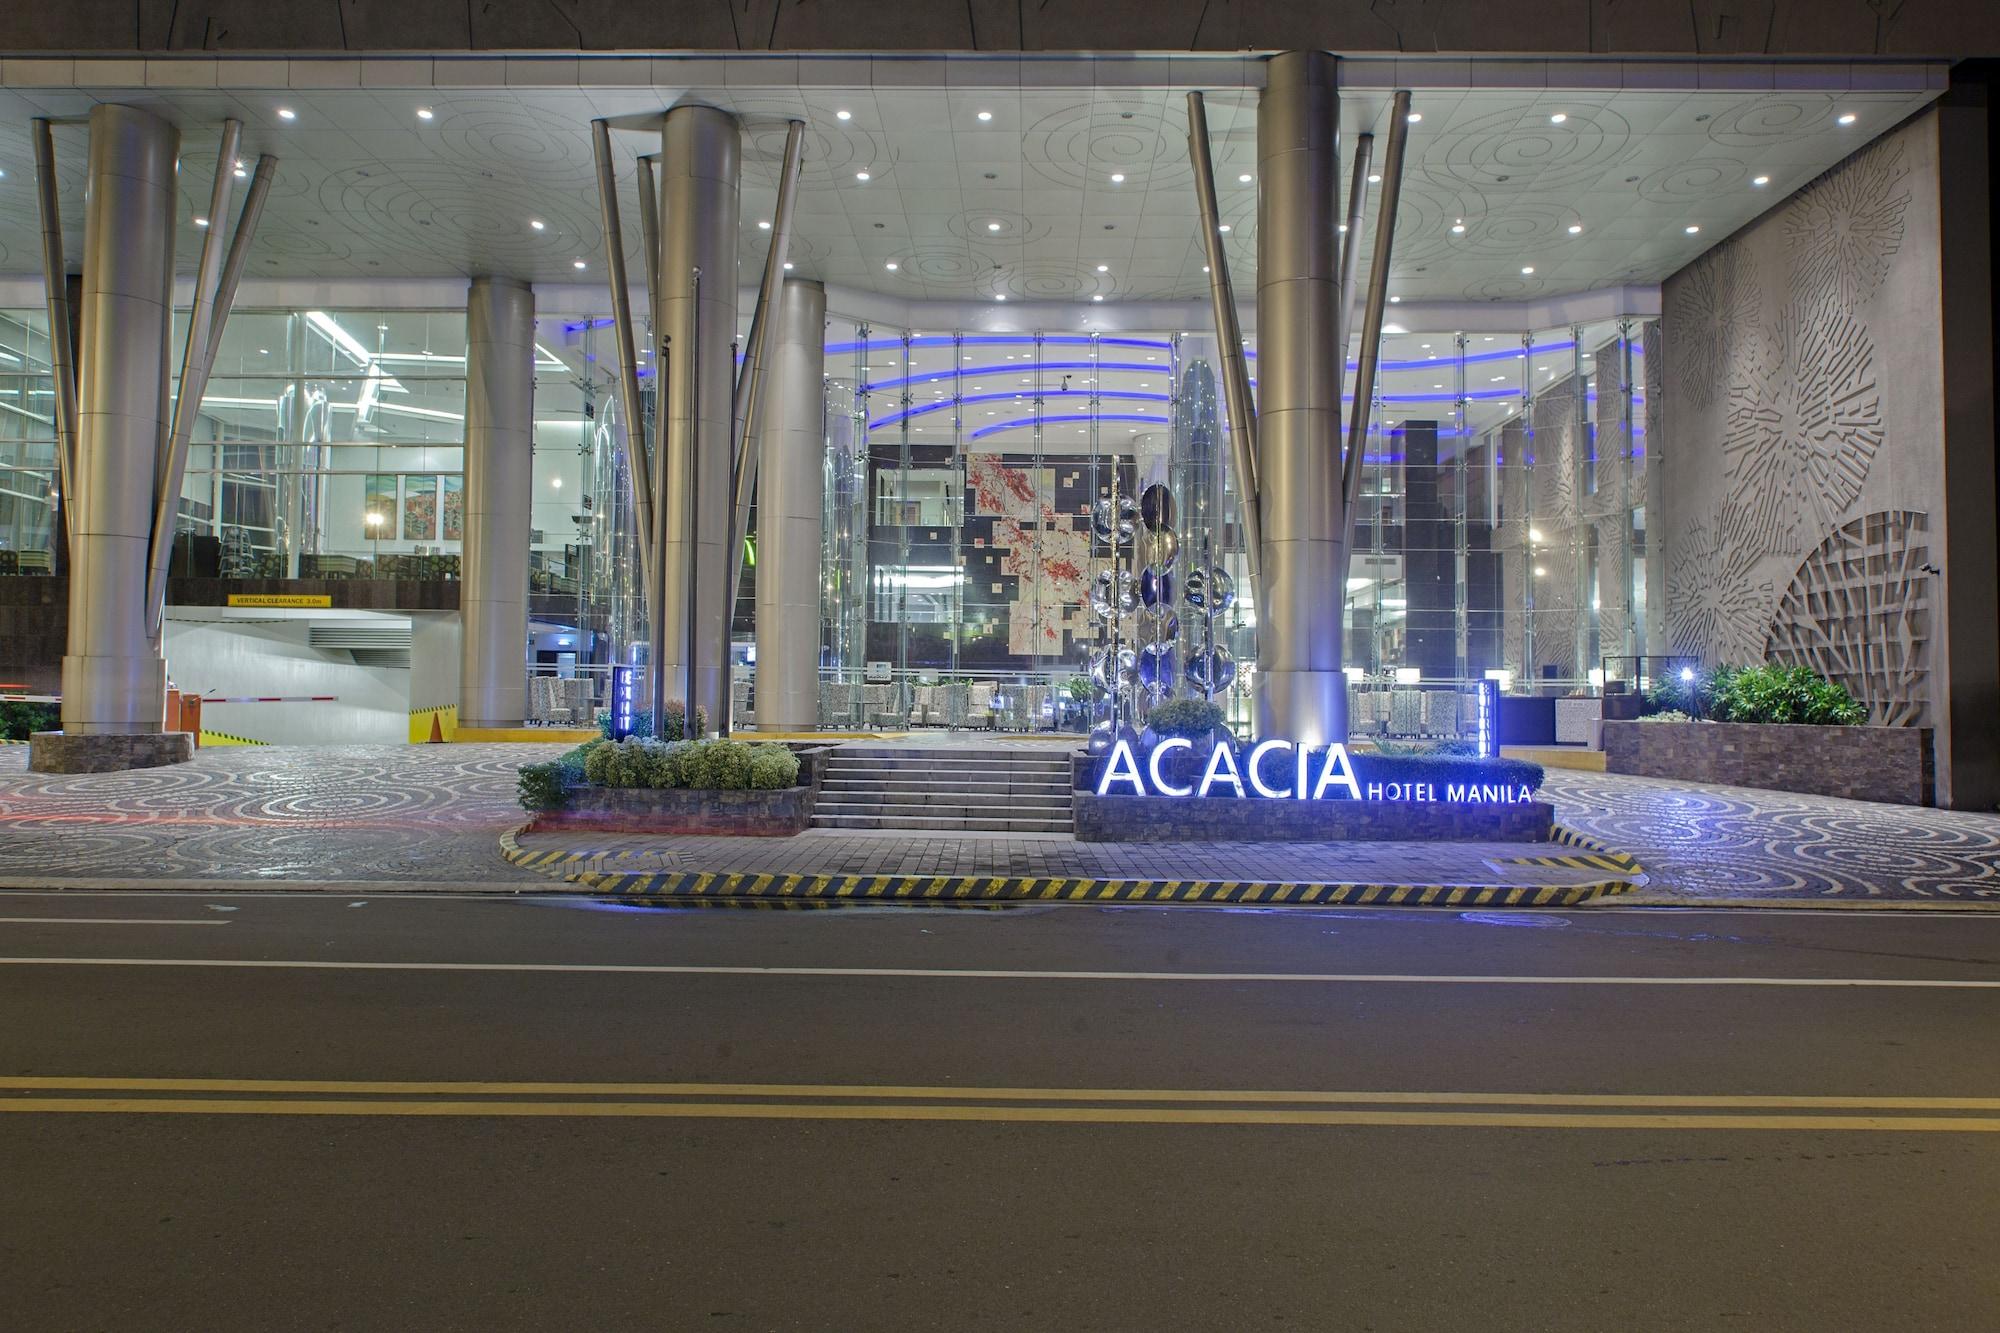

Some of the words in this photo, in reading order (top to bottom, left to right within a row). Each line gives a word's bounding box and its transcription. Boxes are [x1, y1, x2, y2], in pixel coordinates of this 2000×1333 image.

[267, 597, 304, 605] CLEARANCE
[1097, 738, 1362, 800] ACACIA
[1368, 782, 1437, 802] HOTEL
[1447, 784, 1532, 803] MANILA
